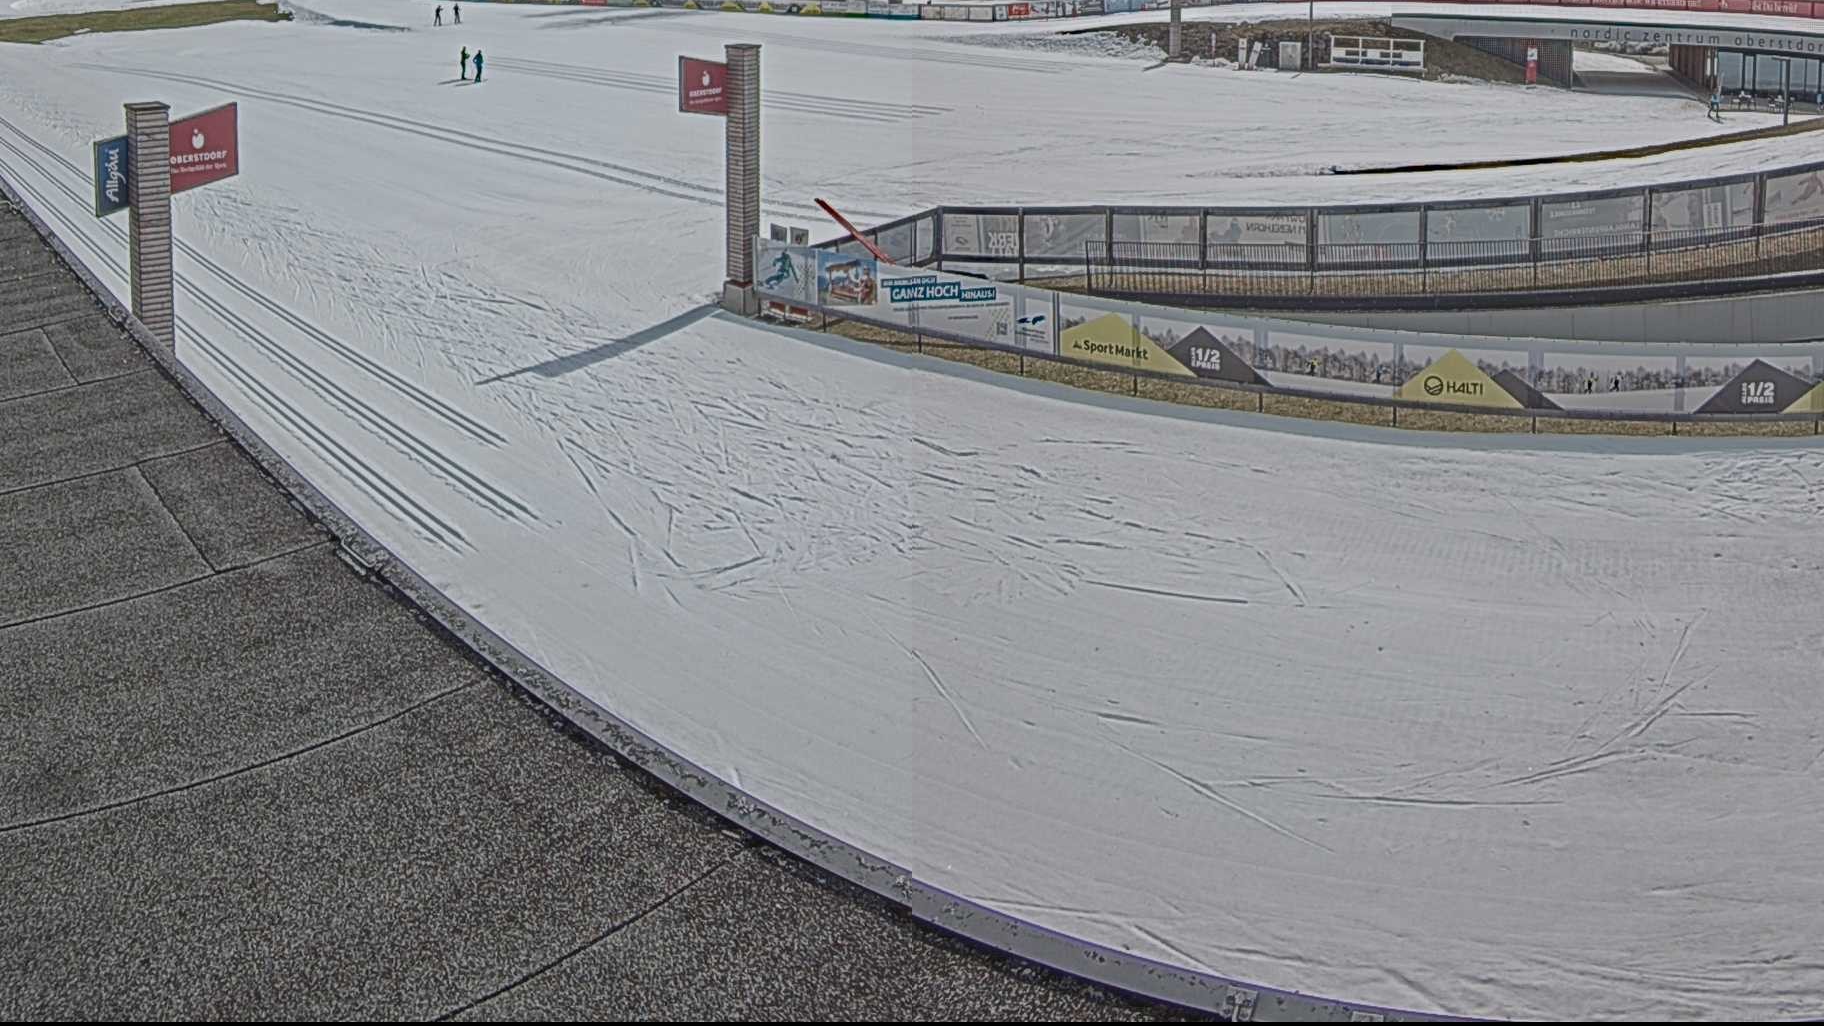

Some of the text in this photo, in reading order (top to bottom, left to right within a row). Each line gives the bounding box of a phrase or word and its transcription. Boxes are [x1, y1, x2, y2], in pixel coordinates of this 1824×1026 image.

[1570, 25, 1631, 41] nordic
[1643, 31, 1720, 44] zentrum
[170, 150, 228, 164] OBERSTDORF
[105, 148, 127, 203] Allgäu
[892, 285, 925, 301] GANZ
[926, 283, 959, 298] HOCH
[1197, 347, 1221, 363] 1/2
[1446, 381, 1484, 395] HALTI
[1748, 381, 1775, 397] 1/2
